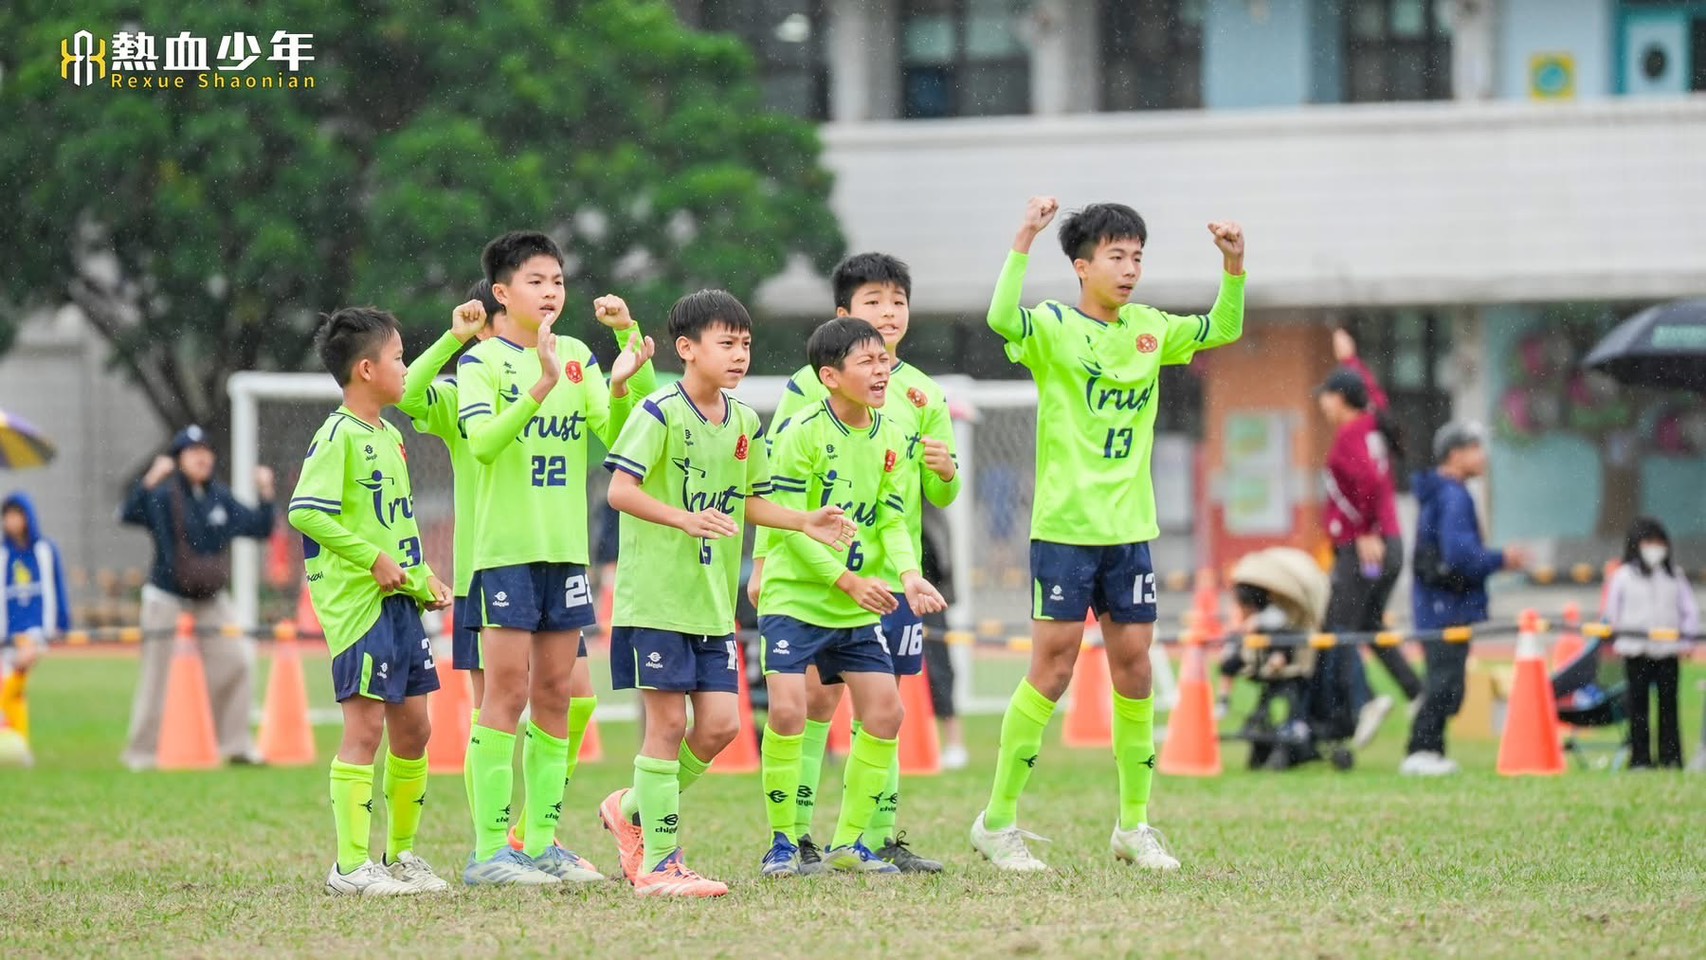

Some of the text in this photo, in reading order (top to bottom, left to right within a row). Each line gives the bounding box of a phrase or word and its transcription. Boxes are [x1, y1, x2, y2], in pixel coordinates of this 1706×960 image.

[516, 411, 587, 443] rust
[1103, 428, 1133, 459] 13
[532, 455, 566, 487] 22
[399, 536, 421, 568] 3
[846, 541, 864, 571] 6
[1133, 573, 1157, 604] 13
[897, 622, 923, 656] 16
[725, 640, 739, 670] 1
